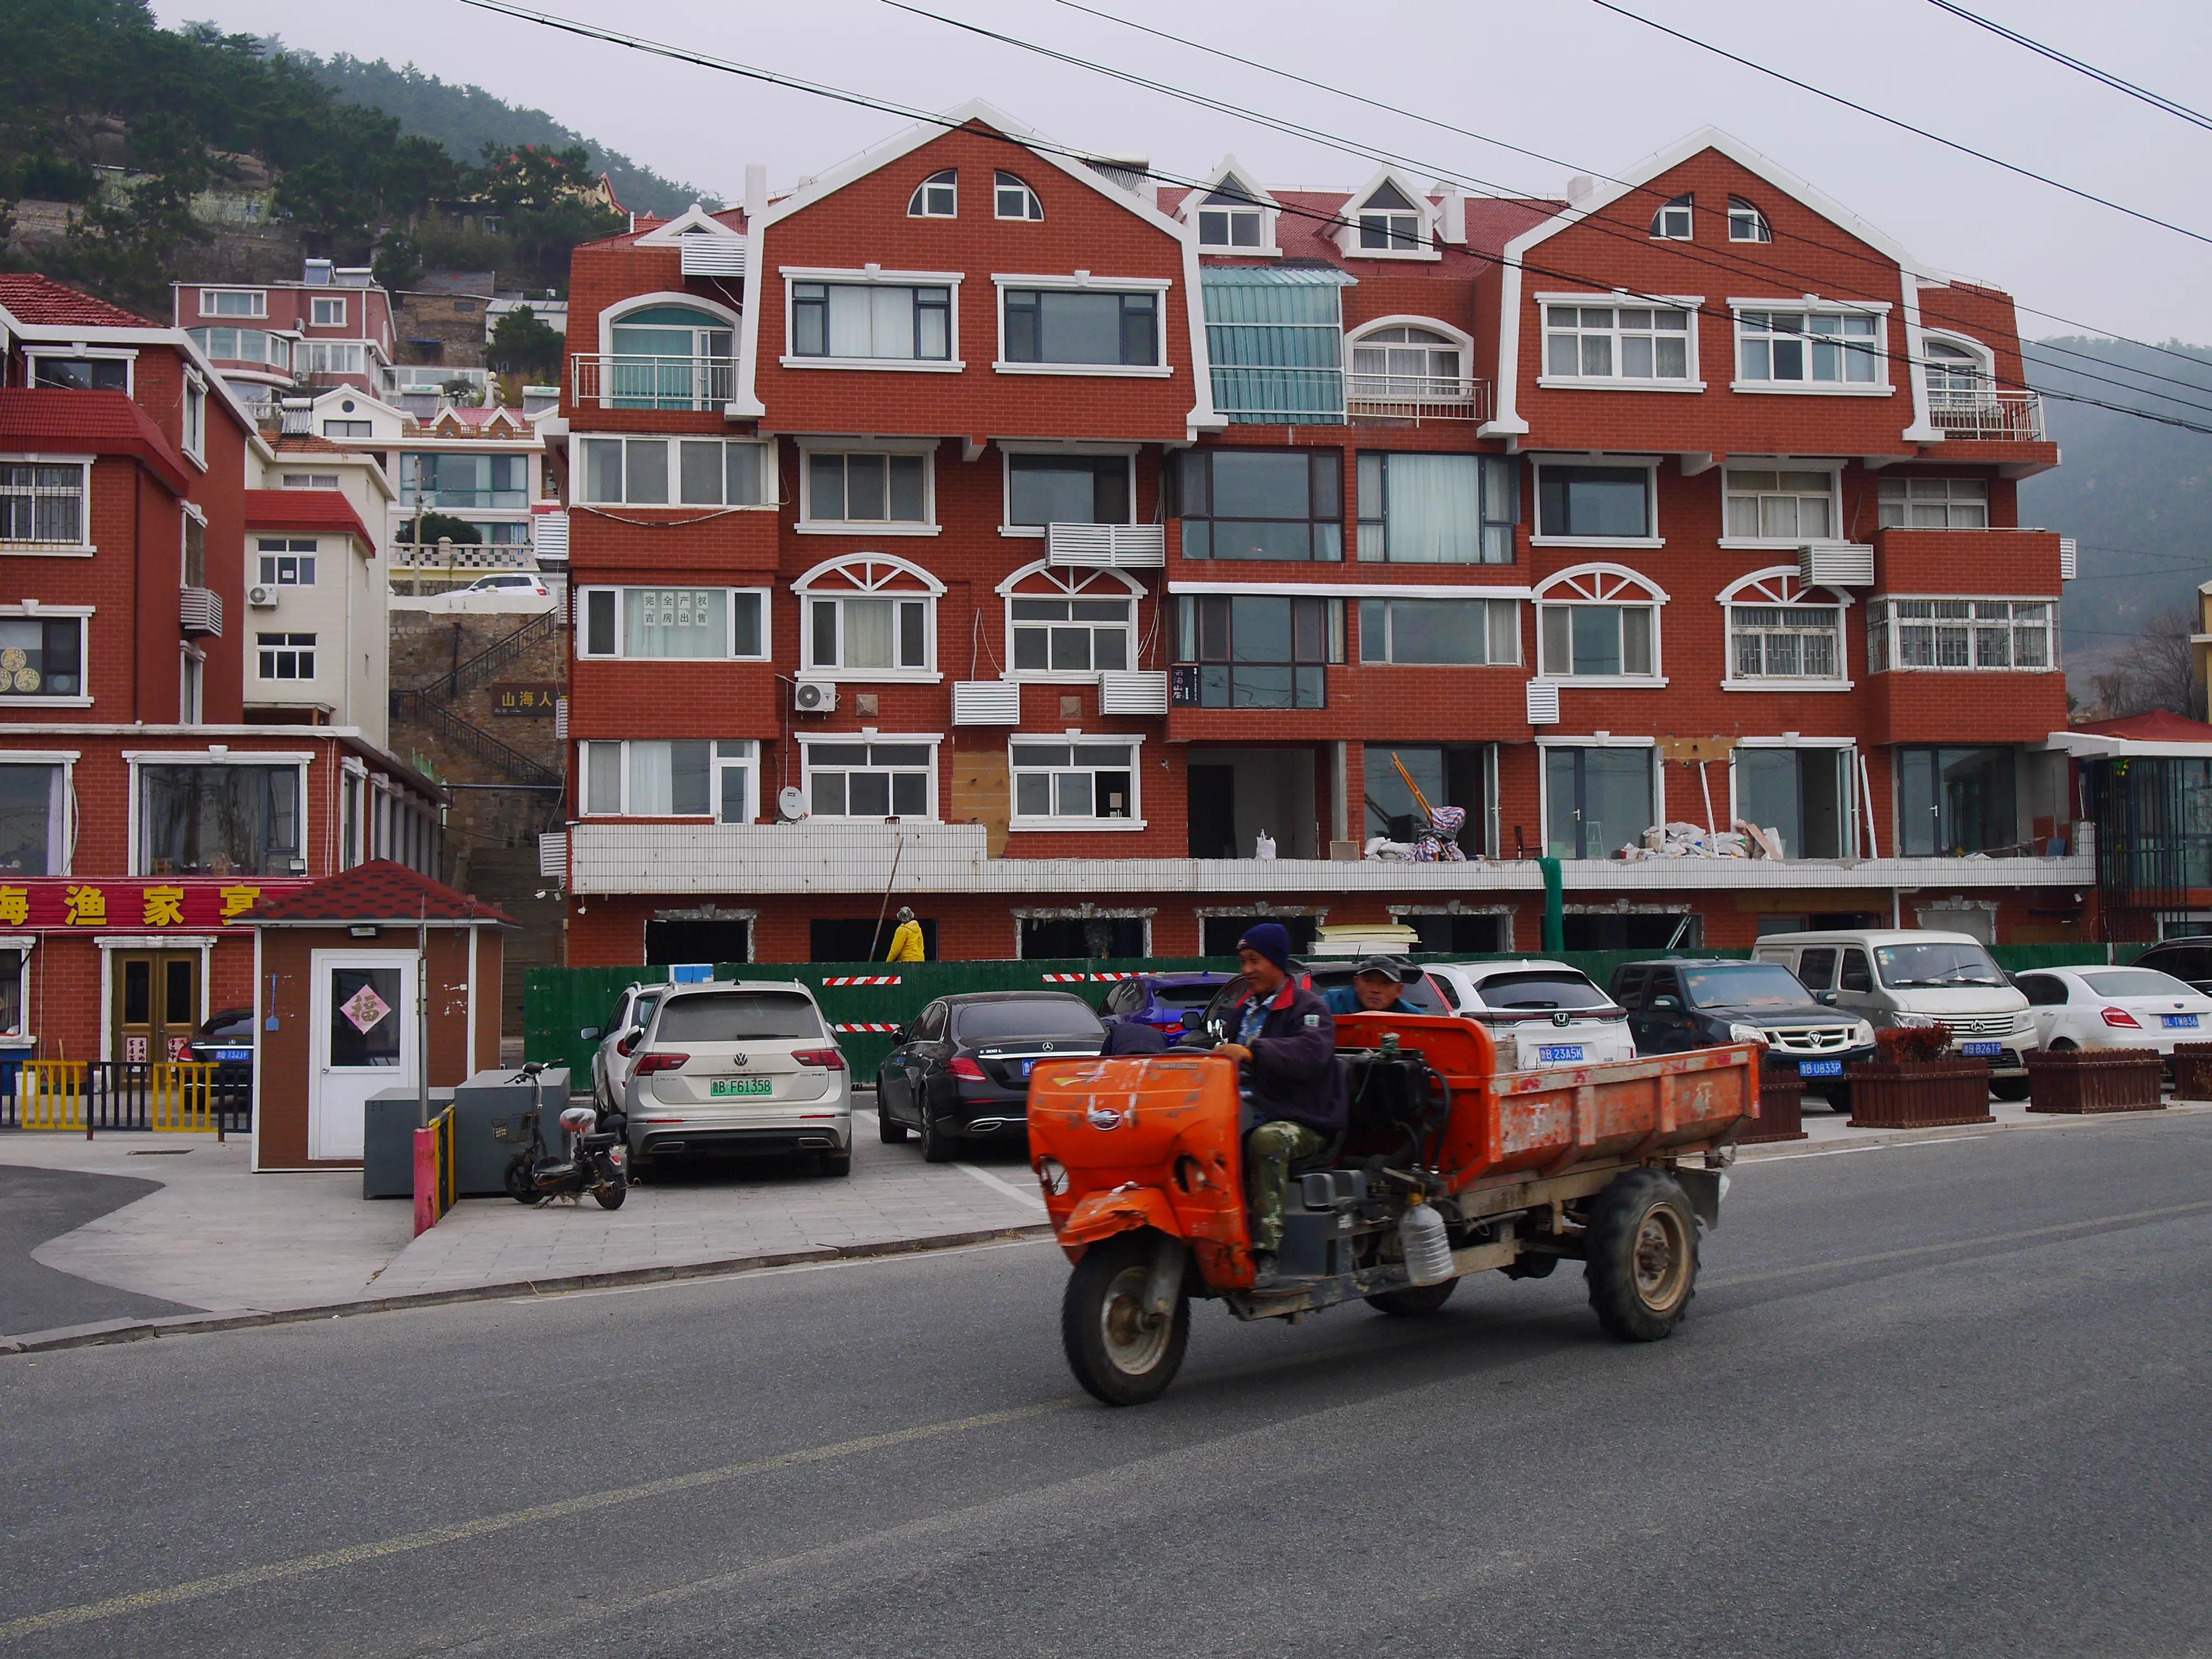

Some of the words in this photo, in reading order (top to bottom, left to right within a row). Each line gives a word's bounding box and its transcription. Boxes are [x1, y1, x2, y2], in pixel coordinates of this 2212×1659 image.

[645, 596, 707, 606] 完全产权
[645, 613, 707, 623] 吉房出售
[502, 691, 568, 706] 山海人
[351, 994, 380, 1022] 福
